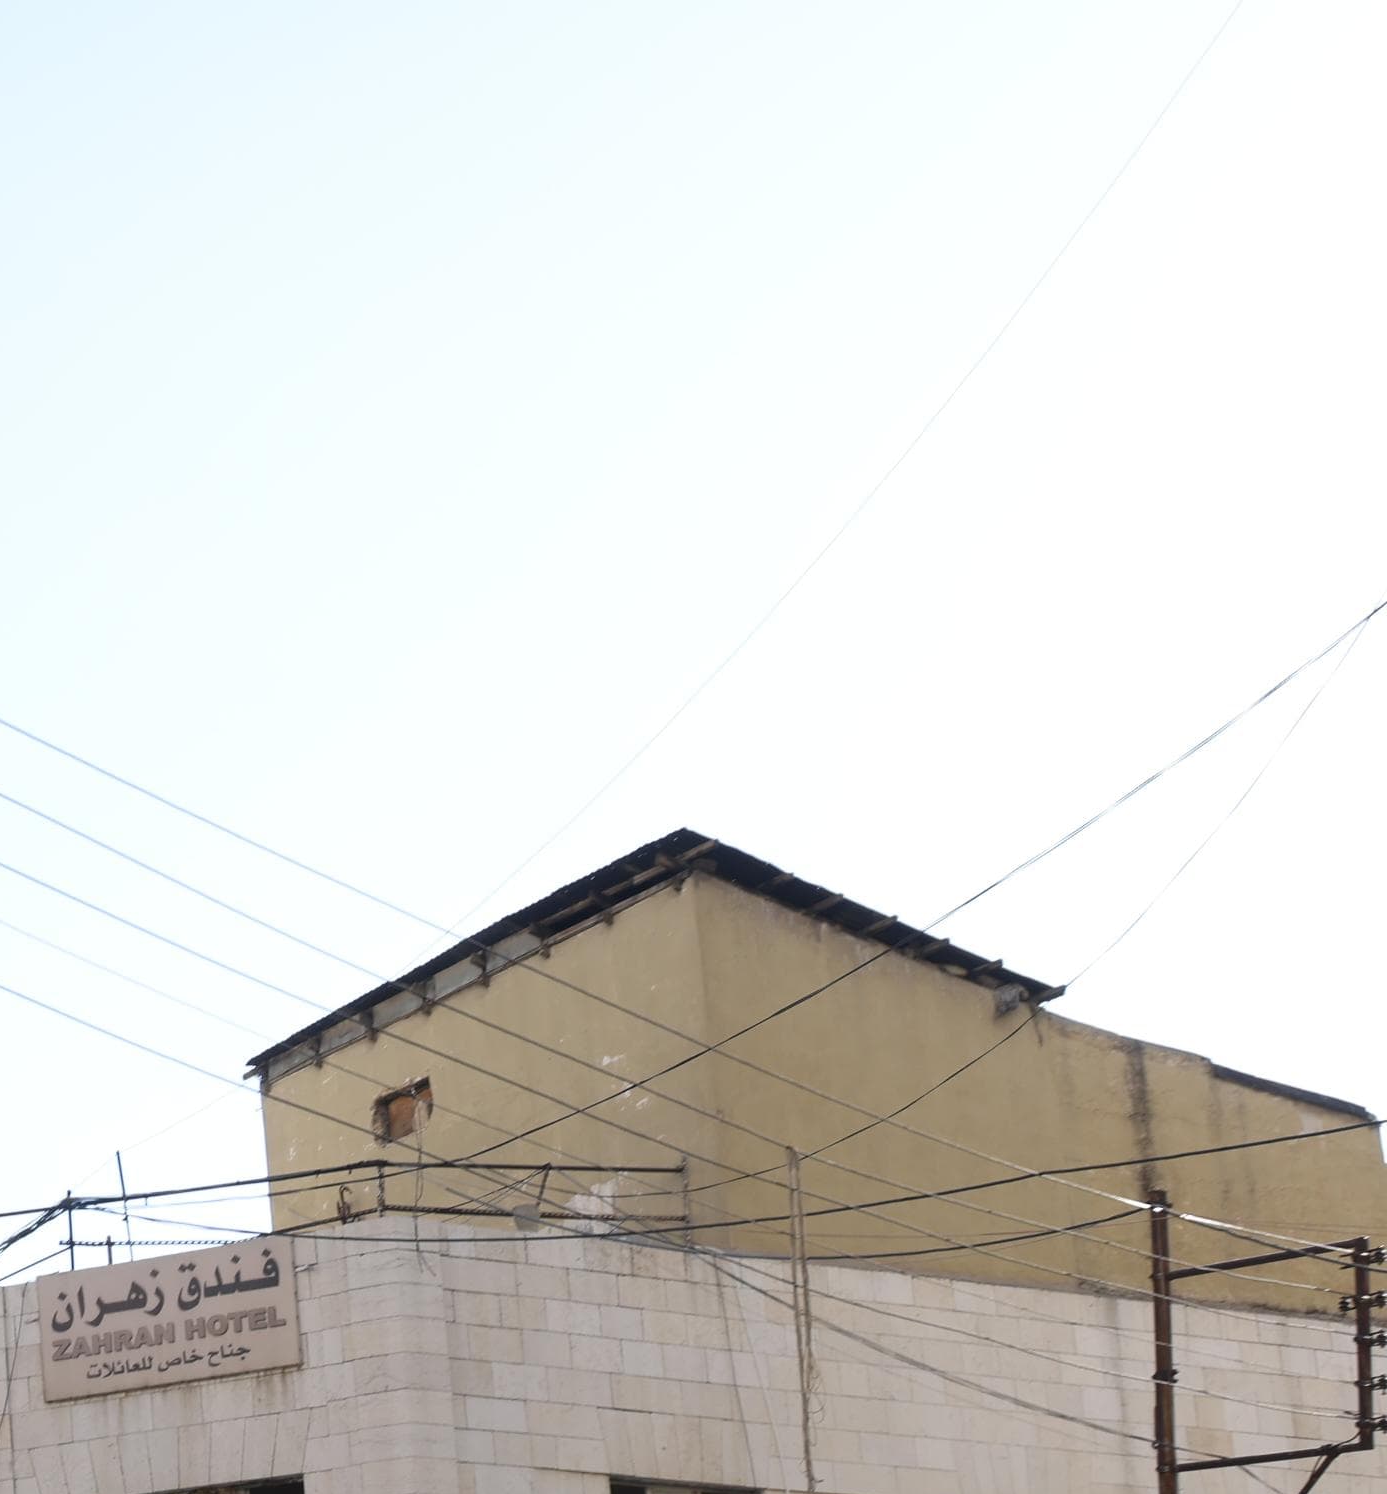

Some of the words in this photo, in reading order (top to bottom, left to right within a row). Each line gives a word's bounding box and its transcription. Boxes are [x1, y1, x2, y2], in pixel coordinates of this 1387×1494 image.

[177, 1248, 280, 1311] فندق
[51, 1269, 165, 1332] زهران
[52, 1321, 175, 1362] ZAHRAN
[184, 1306, 288, 1341] HOTEL
[86, 1356, 153, 1379] للعائلات
[158, 1349, 204, 1372] خاص
[206, 1343, 251, 1367] جناح
